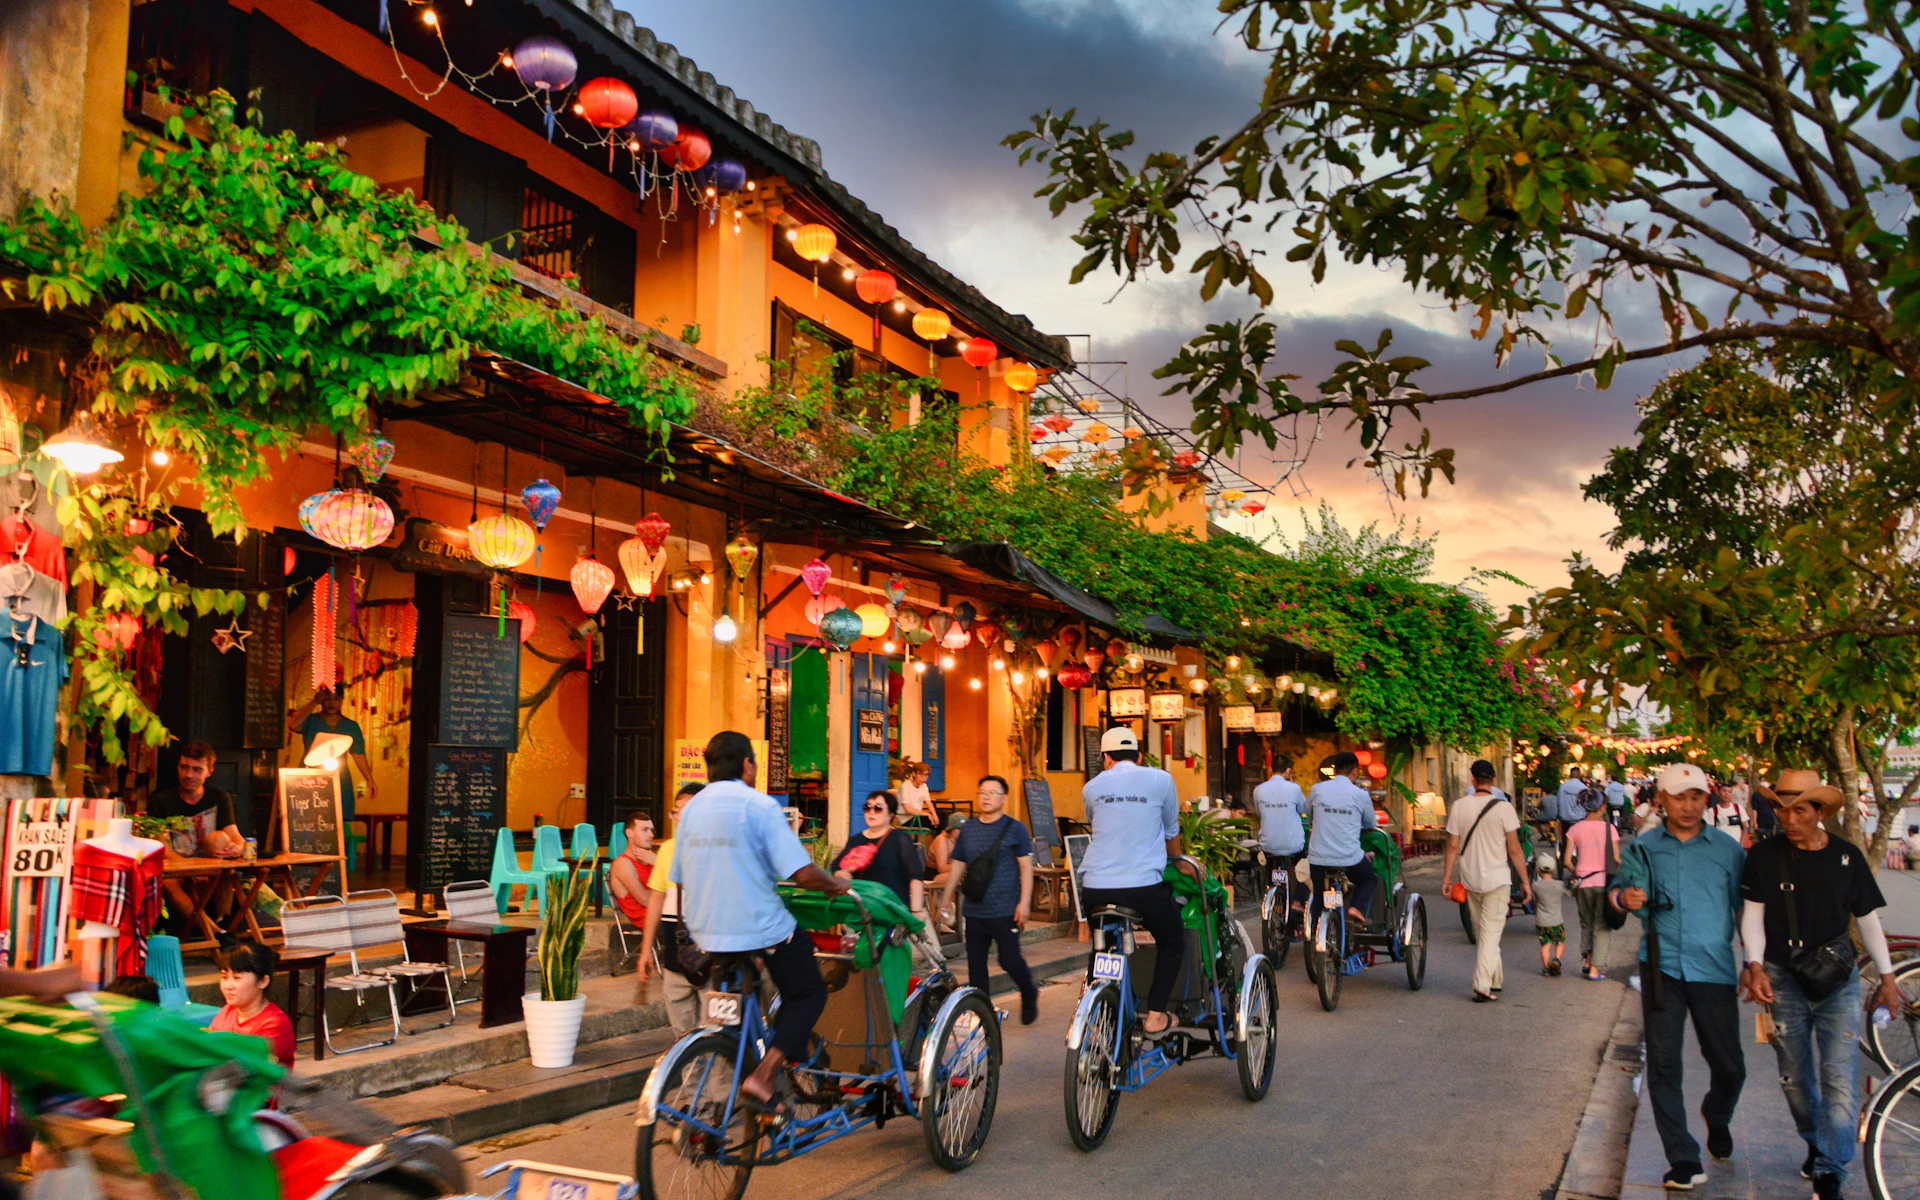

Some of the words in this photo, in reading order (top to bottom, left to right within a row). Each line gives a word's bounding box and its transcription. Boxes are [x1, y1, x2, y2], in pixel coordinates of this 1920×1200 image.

[43, 829, 66, 844] SALE
[1273, 871, 1286, 881] 067
[1325, 892, 1341, 904] 068
[1096, 957, 1120, 976] 009
[708, 997, 738, 1020] 022
